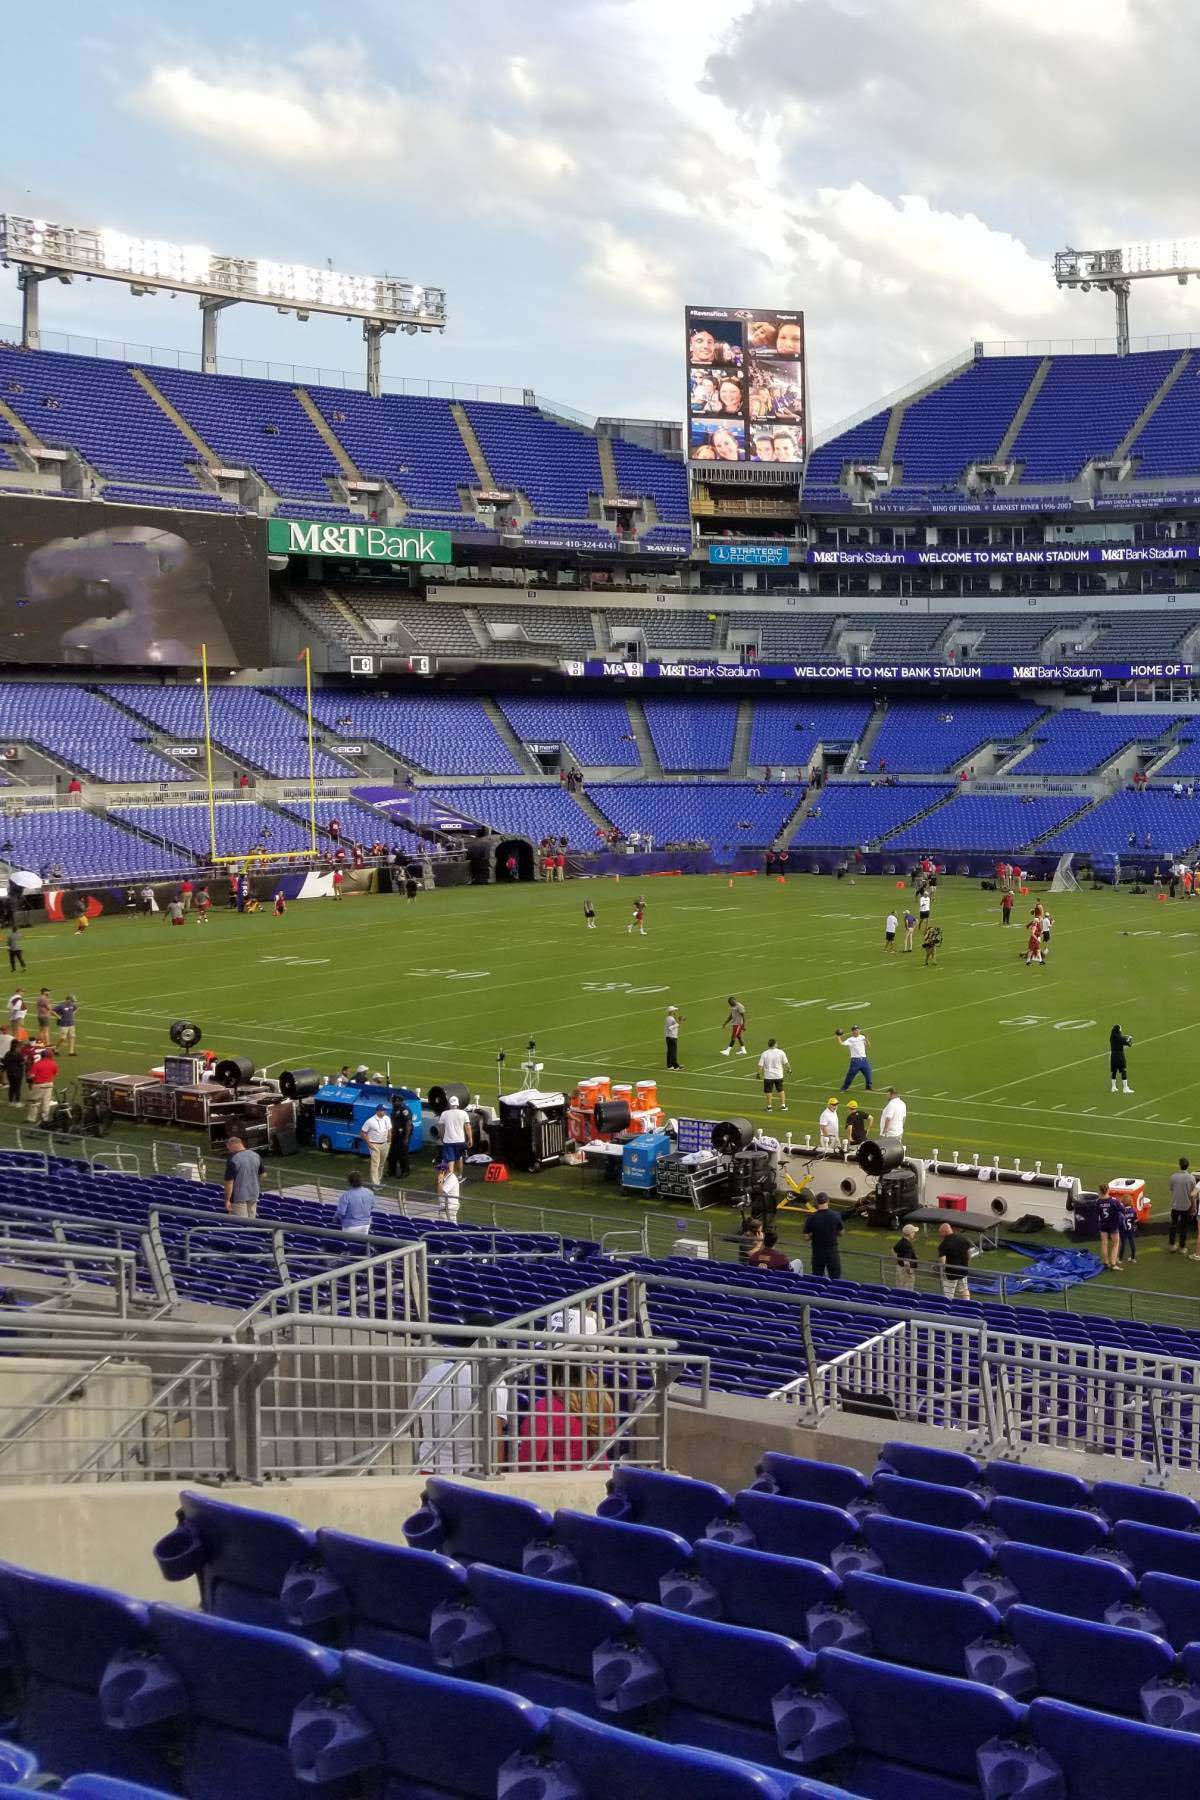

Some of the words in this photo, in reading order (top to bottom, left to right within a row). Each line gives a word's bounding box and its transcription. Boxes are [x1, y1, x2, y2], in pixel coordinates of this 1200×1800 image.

[288, 523, 364, 555] M&T
[367, 528, 436, 560] Bank
[646, 545, 687, 553] RAVENS
[730, 547, 782, 555] STRATEGIC
[1101, 549, 1125, 561] M&T
[1125, 549, 1148, 560] Bank
[1149, 547, 1187, 560] Stadium
[730, 555, 782, 563] FACTORY
[814, 552, 839, 563] M&T
[840, 552, 864, 563] Bank
[865, 551, 905, 564] Stadium
[919, 552, 972, 563] WELCOME
[974, 552, 989, 563] TO
[991, 552, 1014, 562] M&T
[1016, 552, 1043, 562] BANK
[1046, 550, 1089, 562] STADIUM
[659, 665, 687, 676] M&T
[688, 666, 715, 676] Bank
[717, 665, 760, 677] Stadium
[794, 667, 852, 677] WELCOME
[855, 667, 871, 677] TO
[874, 667, 898, 677] M&T
[901, 667, 931, 677] BANK
[934, 667, 980, 677] STADIUM
[1013, 667, 1038, 677] M&T
[1038, 667, 1062, 677] Bank
[1063, 666, 1101, 677] Stadium
[1131, 665, 1162, 676] HOME
[1165, 665, 1180, 675] OF
[998, 1015, 1097, 1030] 50
